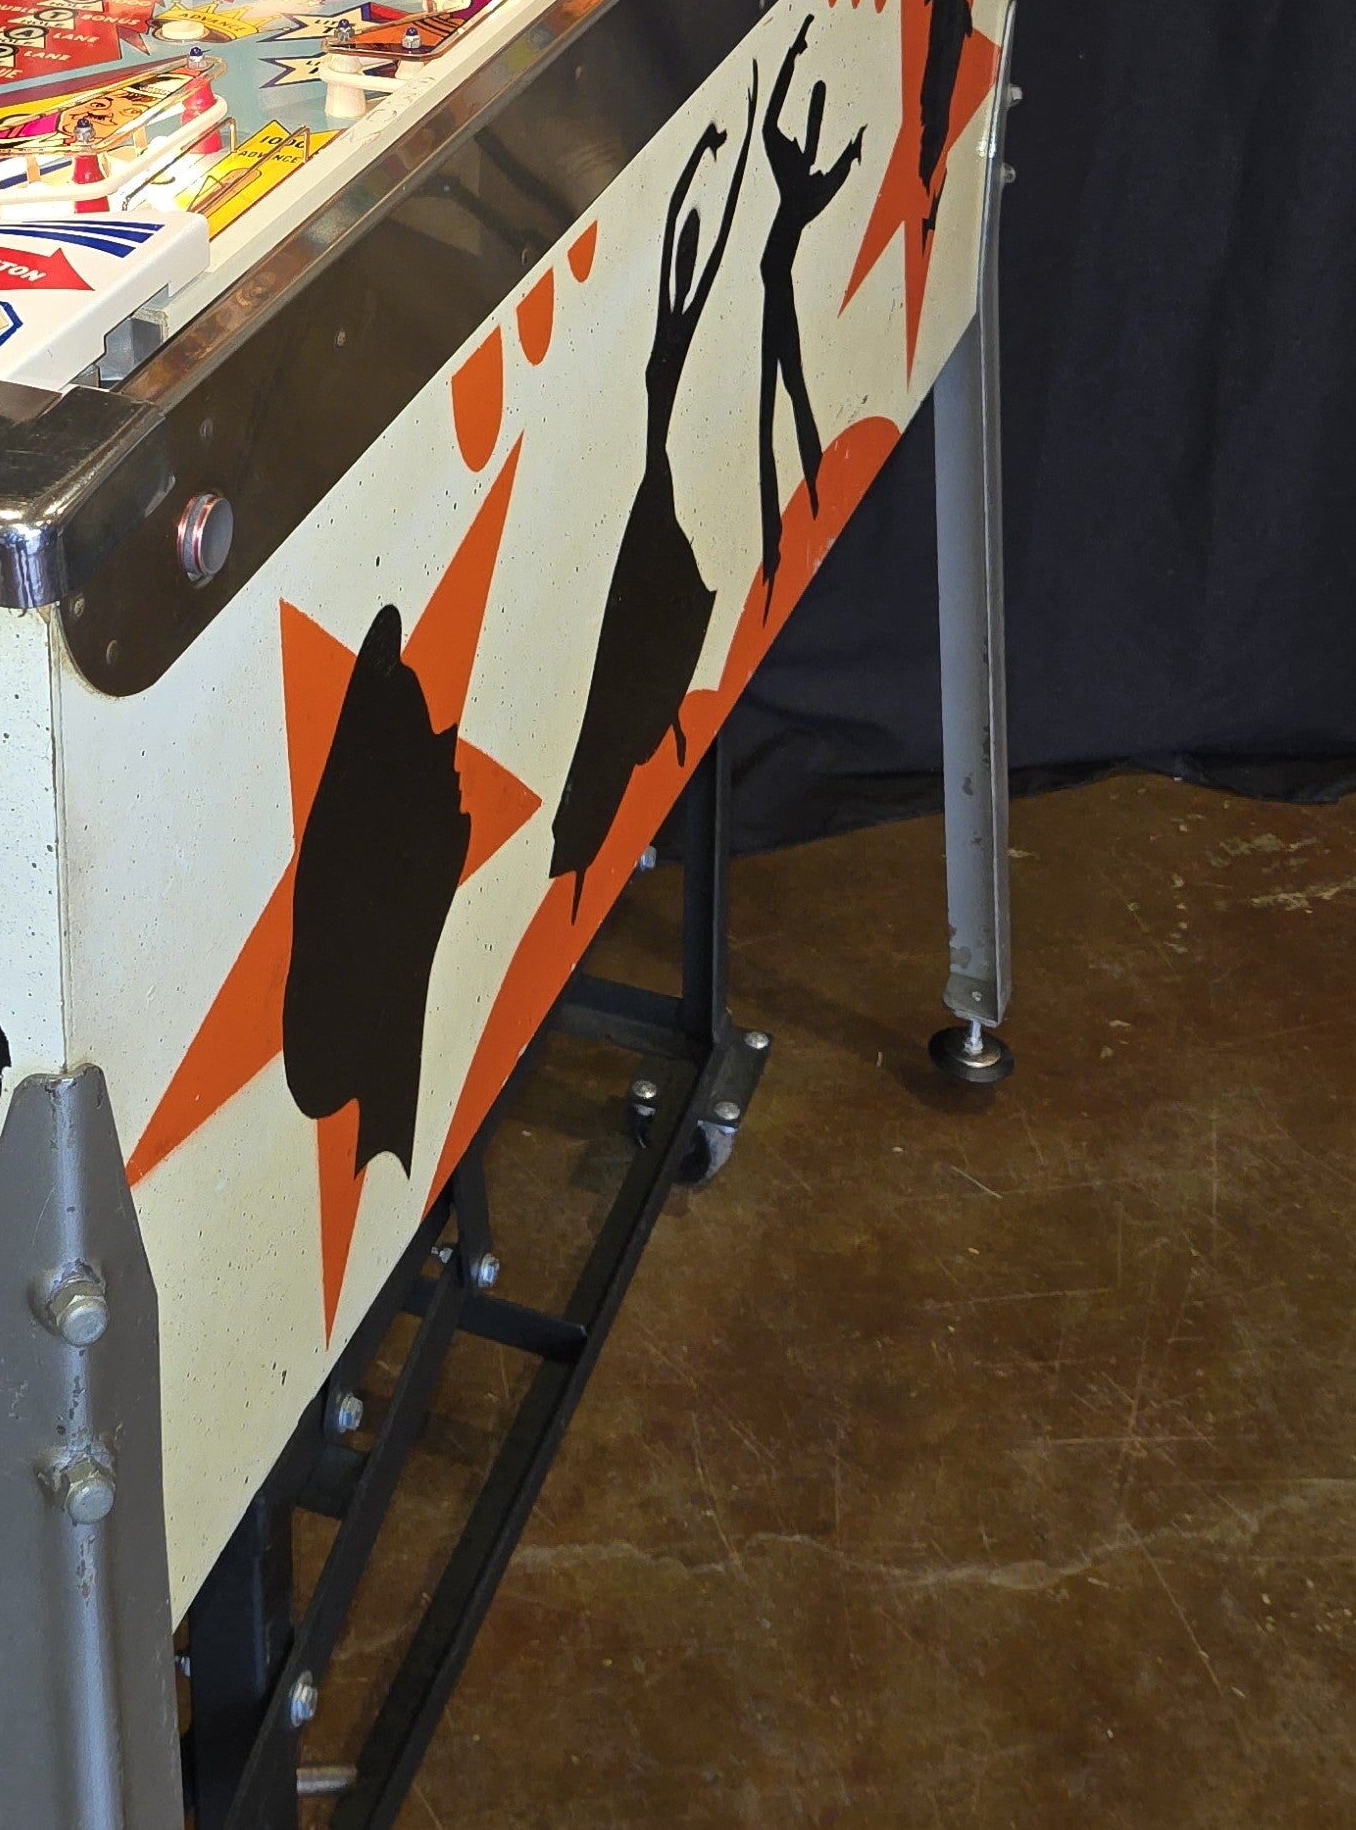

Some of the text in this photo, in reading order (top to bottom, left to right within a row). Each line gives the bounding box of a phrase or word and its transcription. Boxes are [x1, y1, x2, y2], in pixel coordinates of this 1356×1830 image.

[81, 14, 141, 26] BONUS
[178, 12, 249, 32] ADVANCE
[53, 32, 100, 43] LANE
[24, 50, 72, 61] LANE
[238, 150, 302, 163] ADVNCE
